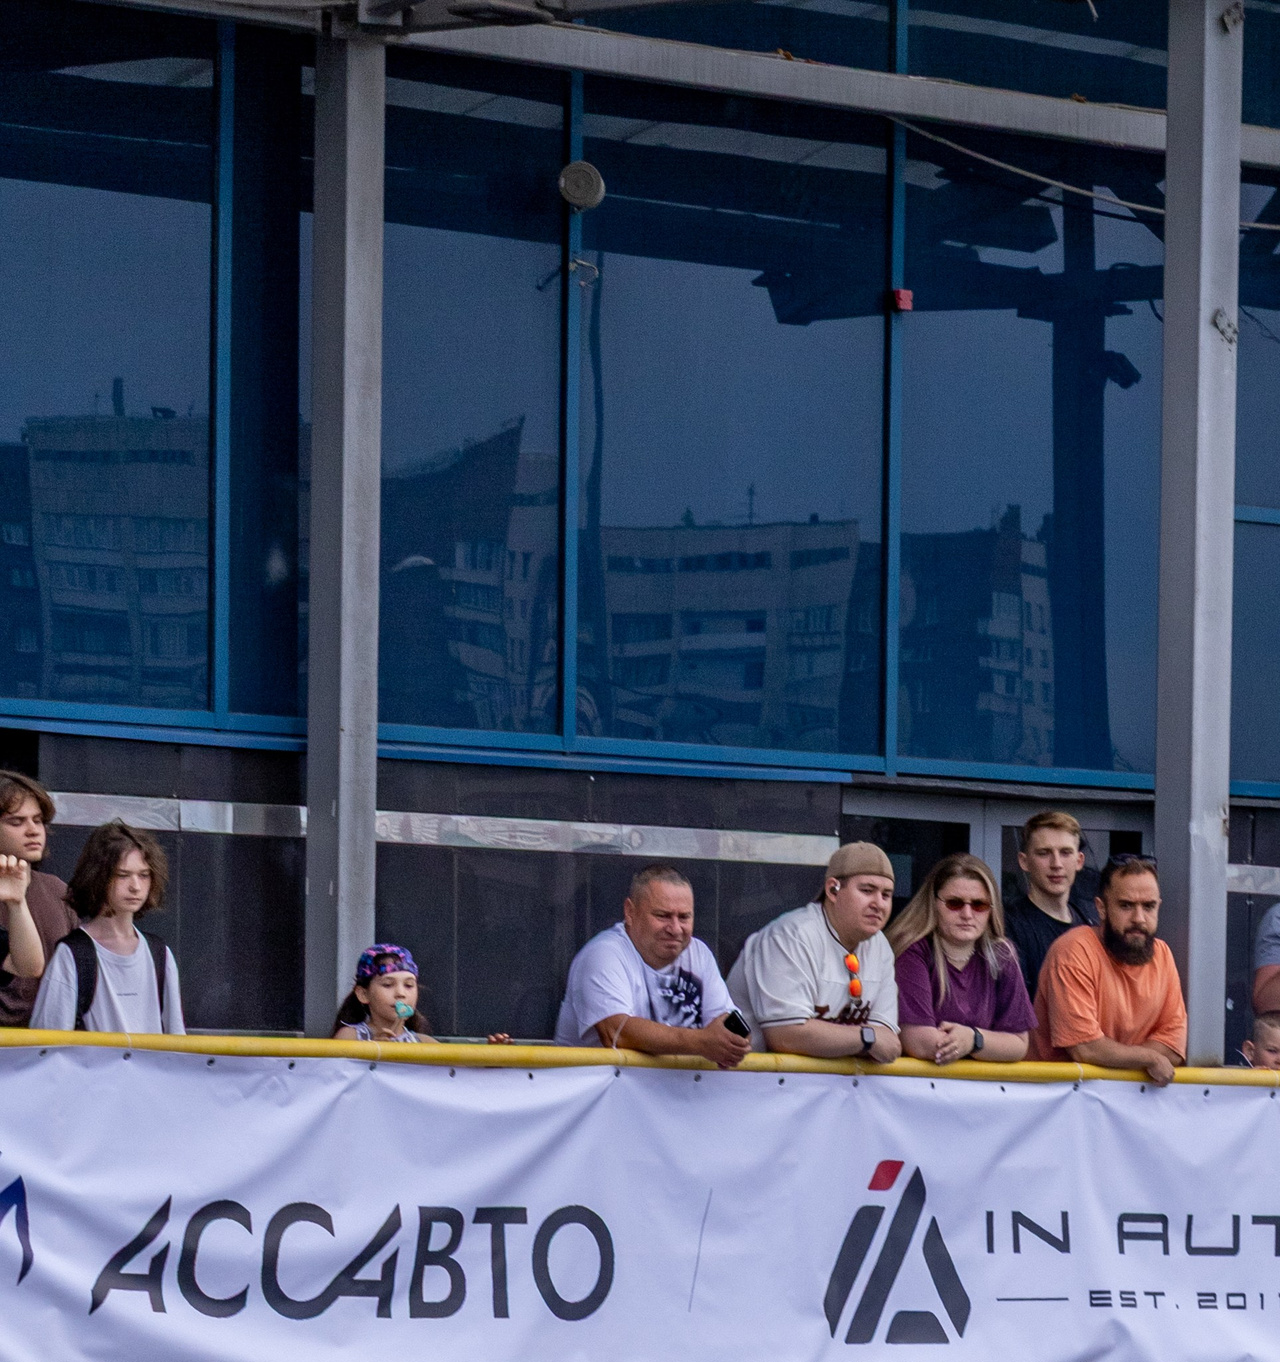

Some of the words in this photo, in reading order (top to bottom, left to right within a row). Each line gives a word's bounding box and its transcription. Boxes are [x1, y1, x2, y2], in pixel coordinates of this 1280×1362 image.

[986, 1210, 1071, 1254] IN
[89, 1194, 615, 1321] АССАВТО
[1088, 1289, 1181, 1310] EST.
